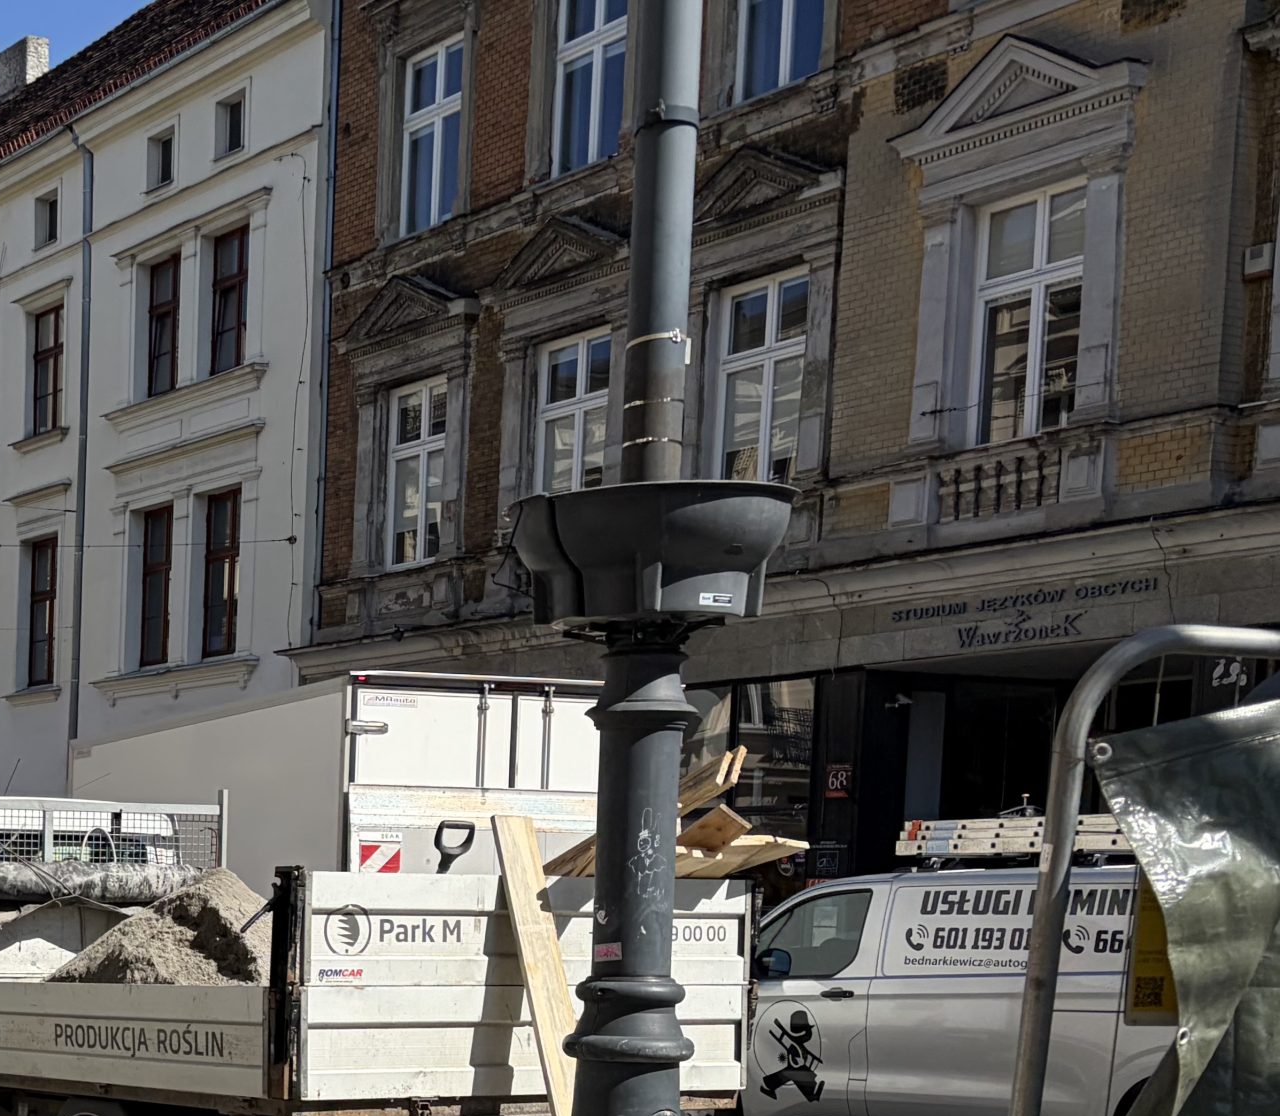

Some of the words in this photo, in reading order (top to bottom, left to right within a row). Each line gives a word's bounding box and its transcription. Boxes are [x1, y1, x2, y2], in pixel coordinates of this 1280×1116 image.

[892, 600, 967, 622] STUDIUM
[976, 588, 1066, 613] JĘZYKÓW
[1075, 577, 1158, 600] OBCYCH
[920, 889, 1023, 916] USŁUGI
[379, 918, 436, 943] Park
[442, 919, 462, 943] M
[682, 925, 703, 942] 00
[706, 925, 727, 942] 00
[932, 926, 967, 950] 601
[971, 927, 1003, 950] 193
[318, 968, 363, 978] ROMCAR
[54, 1023, 149, 1058] PRODUKCJA
[157, 1024, 225, 1058] ROŚLIN
